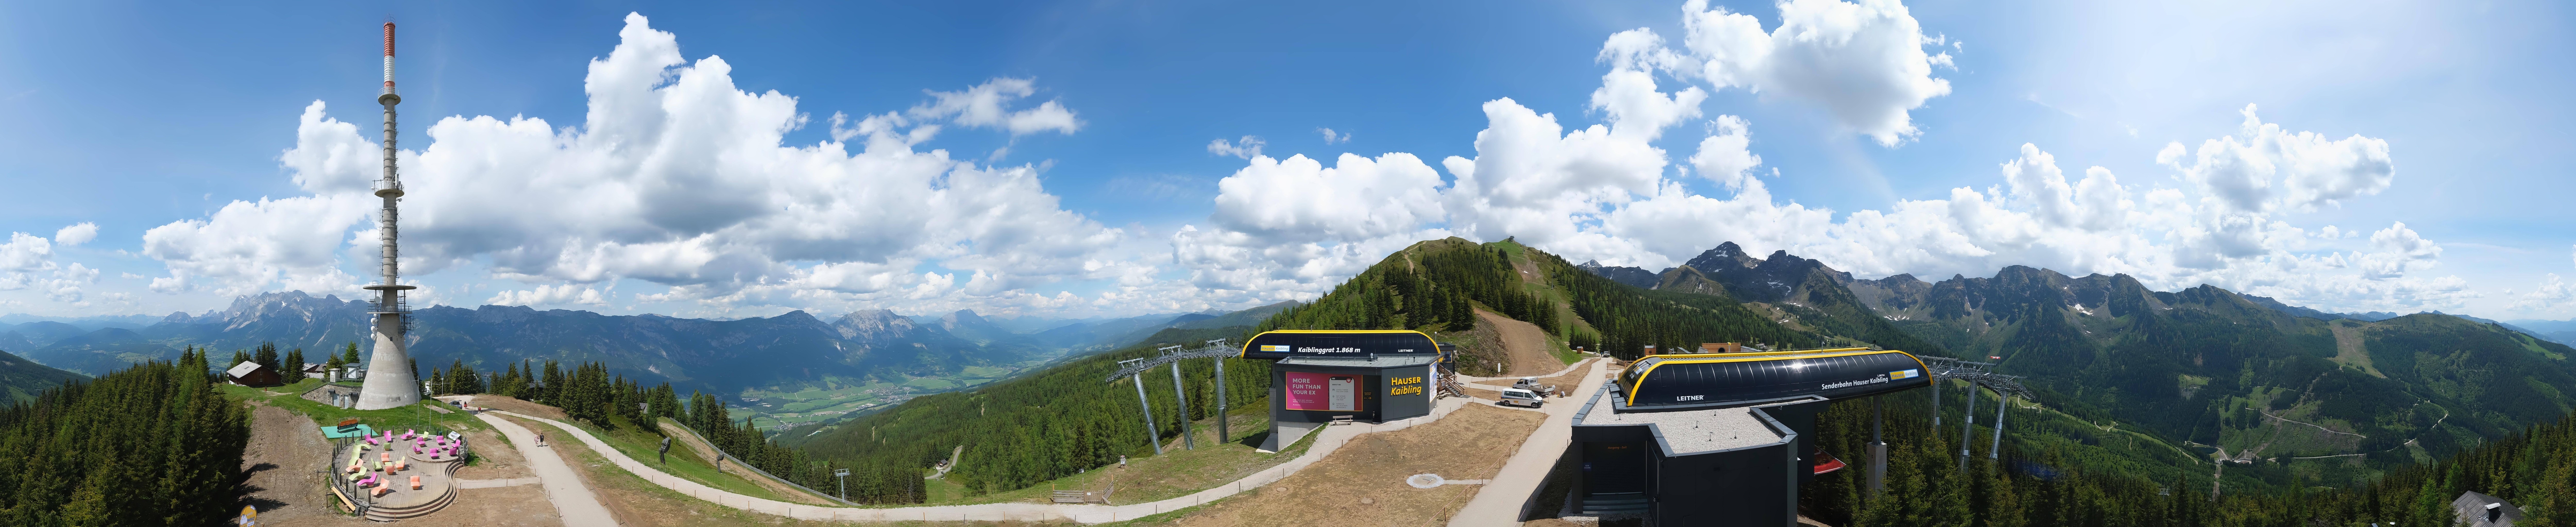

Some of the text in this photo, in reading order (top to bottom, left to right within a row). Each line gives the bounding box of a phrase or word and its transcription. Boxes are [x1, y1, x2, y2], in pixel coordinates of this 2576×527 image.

[1391, 377, 1421, 385] HAUSER
[1822, 381, 1852, 390] Senderbahn
[1391, 385, 1421, 395] Kaibling
